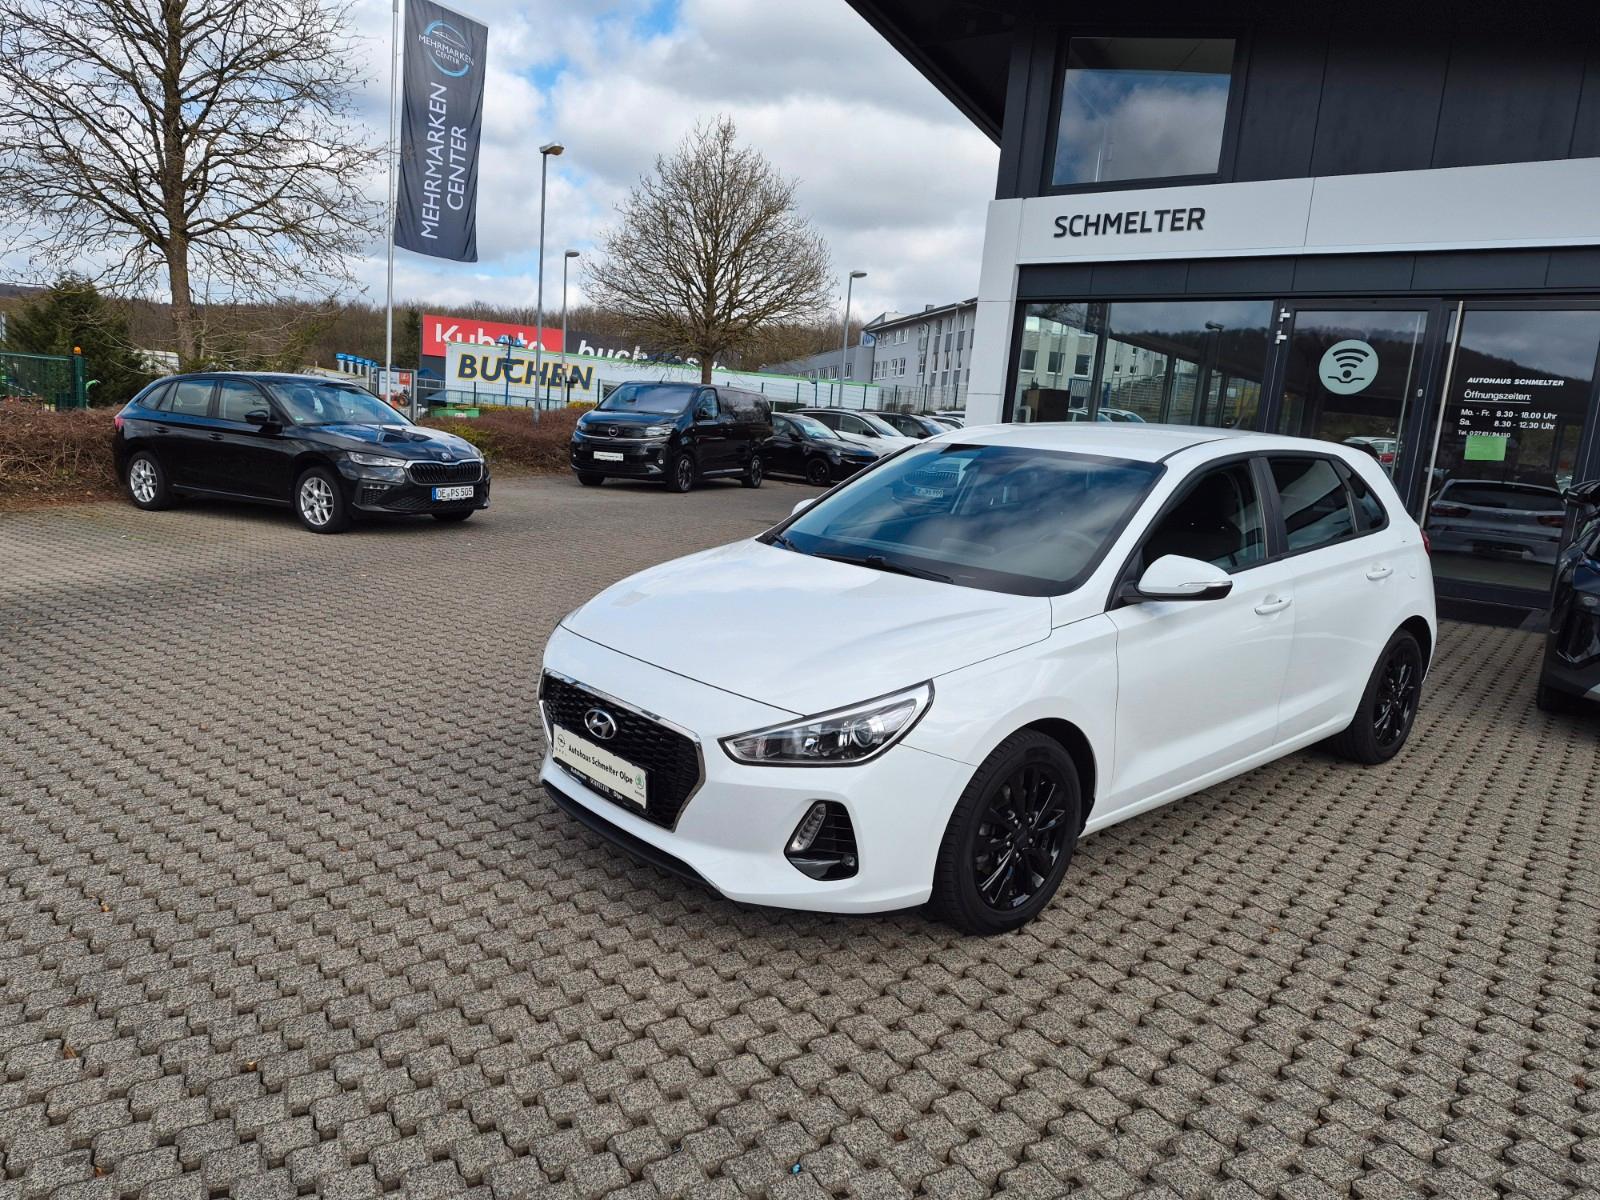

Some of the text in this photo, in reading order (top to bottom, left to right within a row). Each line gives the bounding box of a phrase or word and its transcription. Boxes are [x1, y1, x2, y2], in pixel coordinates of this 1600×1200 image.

[418, 33, 474, 66] MEHRMARKEN
[435, 49, 460, 65] CENTER
[421, 82, 448, 239] MEHRMARKEN
[447, 126, 467, 210] CENTER
[1053, 207, 1206, 238] SCHMELTER
[458, 353, 593, 390] BUCHEN
[1467, 377, 1564, 386] AUTOHAUS SCHMELTER
[1464, 389, 1532, 400] Öffnungszeiten:
[1481, 409, 1490, 417] Fr.
[1496, 410, 1513, 418] 8.30
[1521, 411, 1541, 419] 18.00
[1543, 412, 1557, 420] Uhr
[1494, 420, 1511, 428] 8.30
[1519, 421, 1539, 429] 12.30
[1541, 422, 1555, 430] Uhr
[569, 745, 591, 763] Autohaus
[592, 756, 619, 777] Schmelter
[620, 770, 633, 784] Olpe
